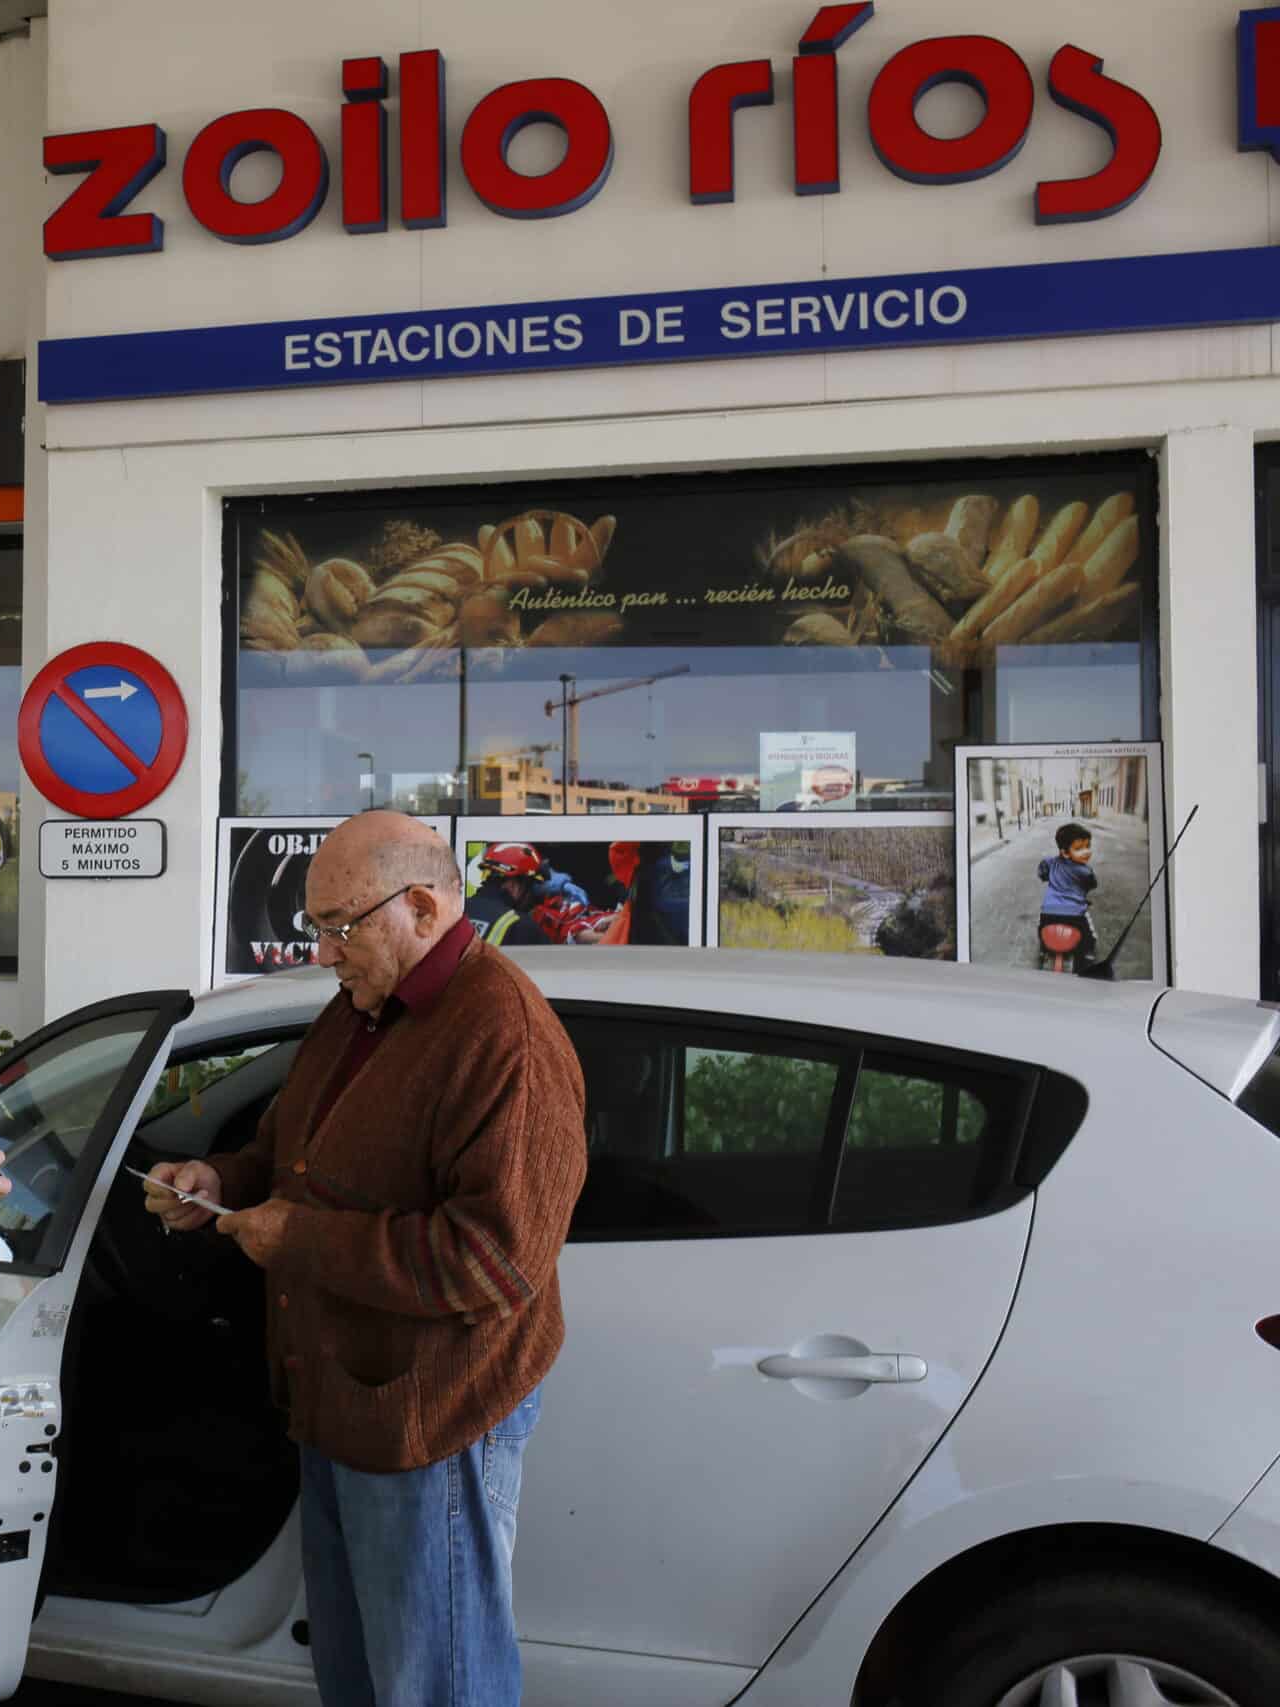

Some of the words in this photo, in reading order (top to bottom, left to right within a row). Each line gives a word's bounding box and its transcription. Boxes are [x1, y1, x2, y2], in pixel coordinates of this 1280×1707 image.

[42, 49, 614, 262] zoilo
[688, 1, 1162, 226] ríos
[284, 313, 584, 372] ESTACIONES
[618, 307, 684, 347] DE
[720, 285, 967, 341] SERVICIO
[510, 584, 616, 610] Auténtico
[619, 594, 669, 613] pan
[704, 582, 775, 603] recién
[781, 575, 851, 601] hecho
[64, 827, 137, 839] PERMITIDO
[268, 833, 328, 855] OBJ
[72, 841, 129, 855] MÁXIMO
[62, 859, 69, 870] 5
[78, 858, 141, 870] MINUTOS
